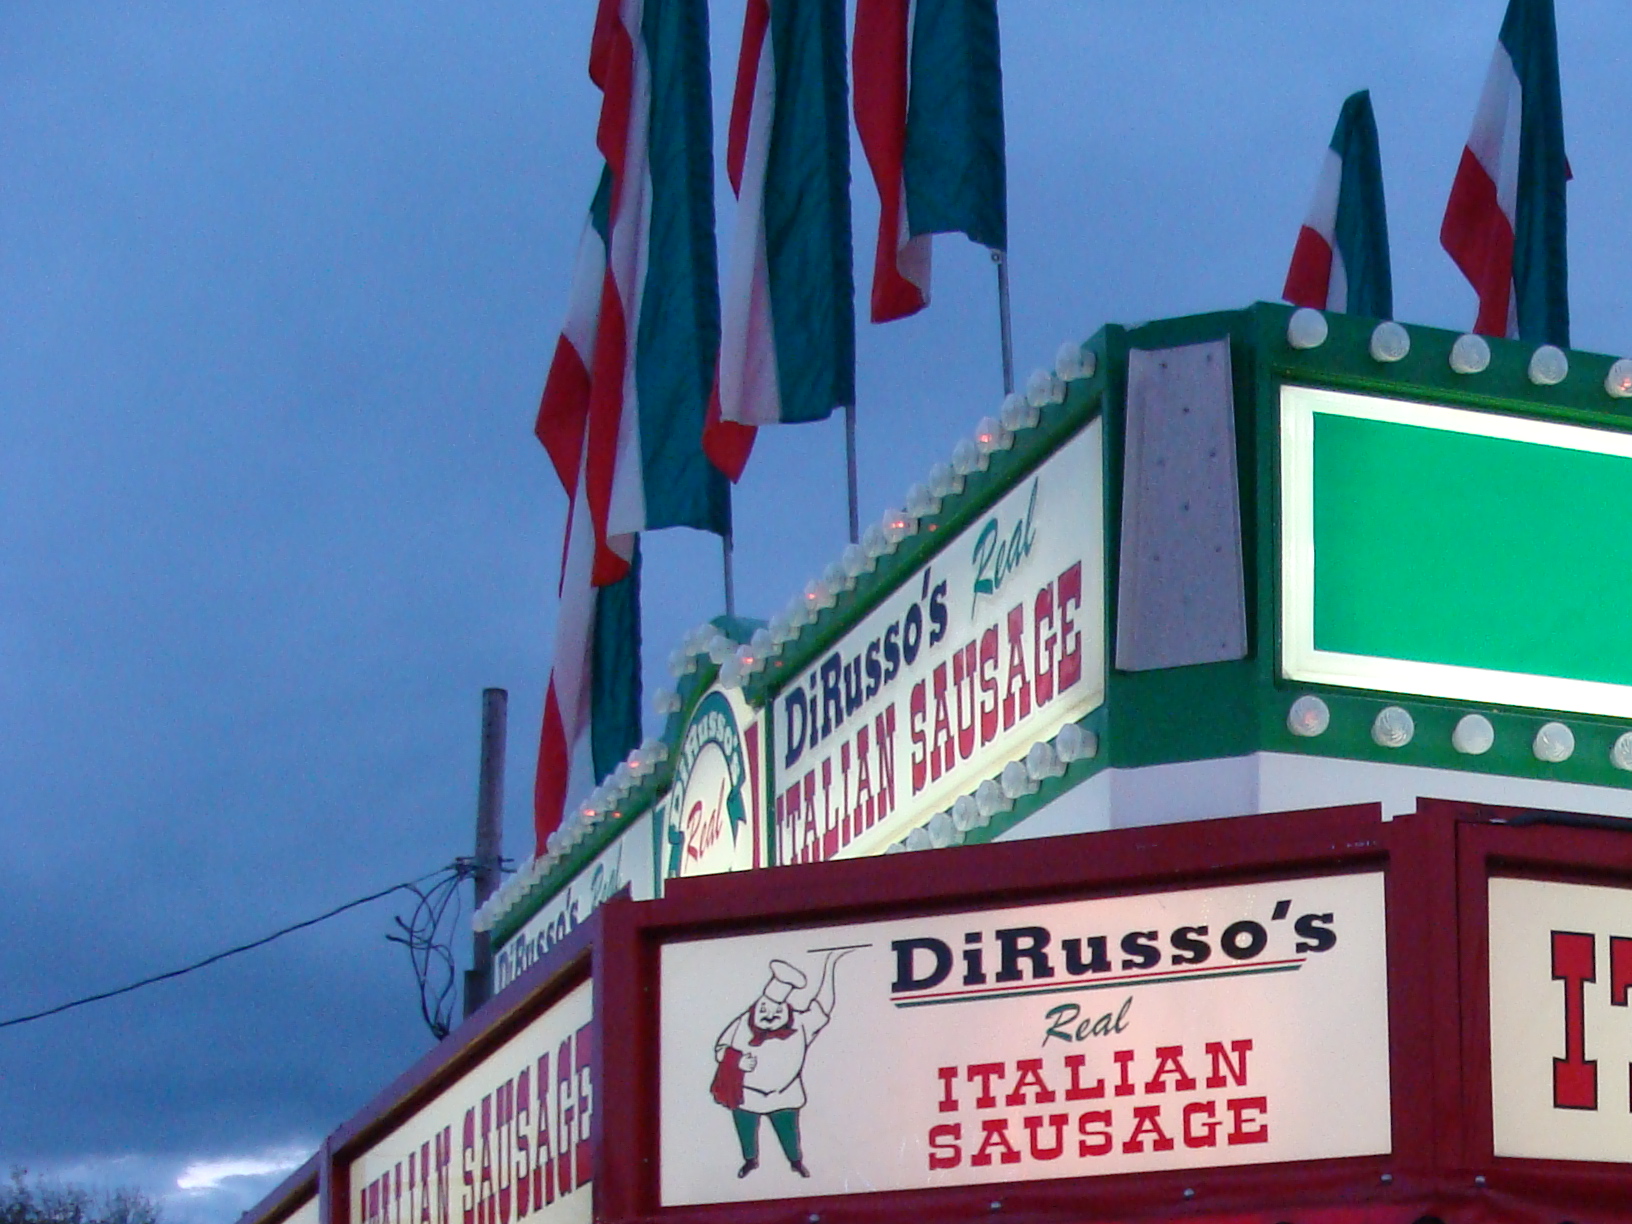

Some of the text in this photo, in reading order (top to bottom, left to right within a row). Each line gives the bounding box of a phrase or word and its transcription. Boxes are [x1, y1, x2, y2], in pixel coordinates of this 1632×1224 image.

[785, 477, 1039, 770] DiRusso's Real
[777, 560, 1083, 866] ITALIAN SAUSAGE
[684, 777, 726, 874] Real
[891, 899, 1338, 994] DiRusso's
[1042, 995, 1133, 1048] Real
[937, 1038, 1254, 1112] ITALIAN
[928, 1097, 1270, 1172] SAUSAGE
